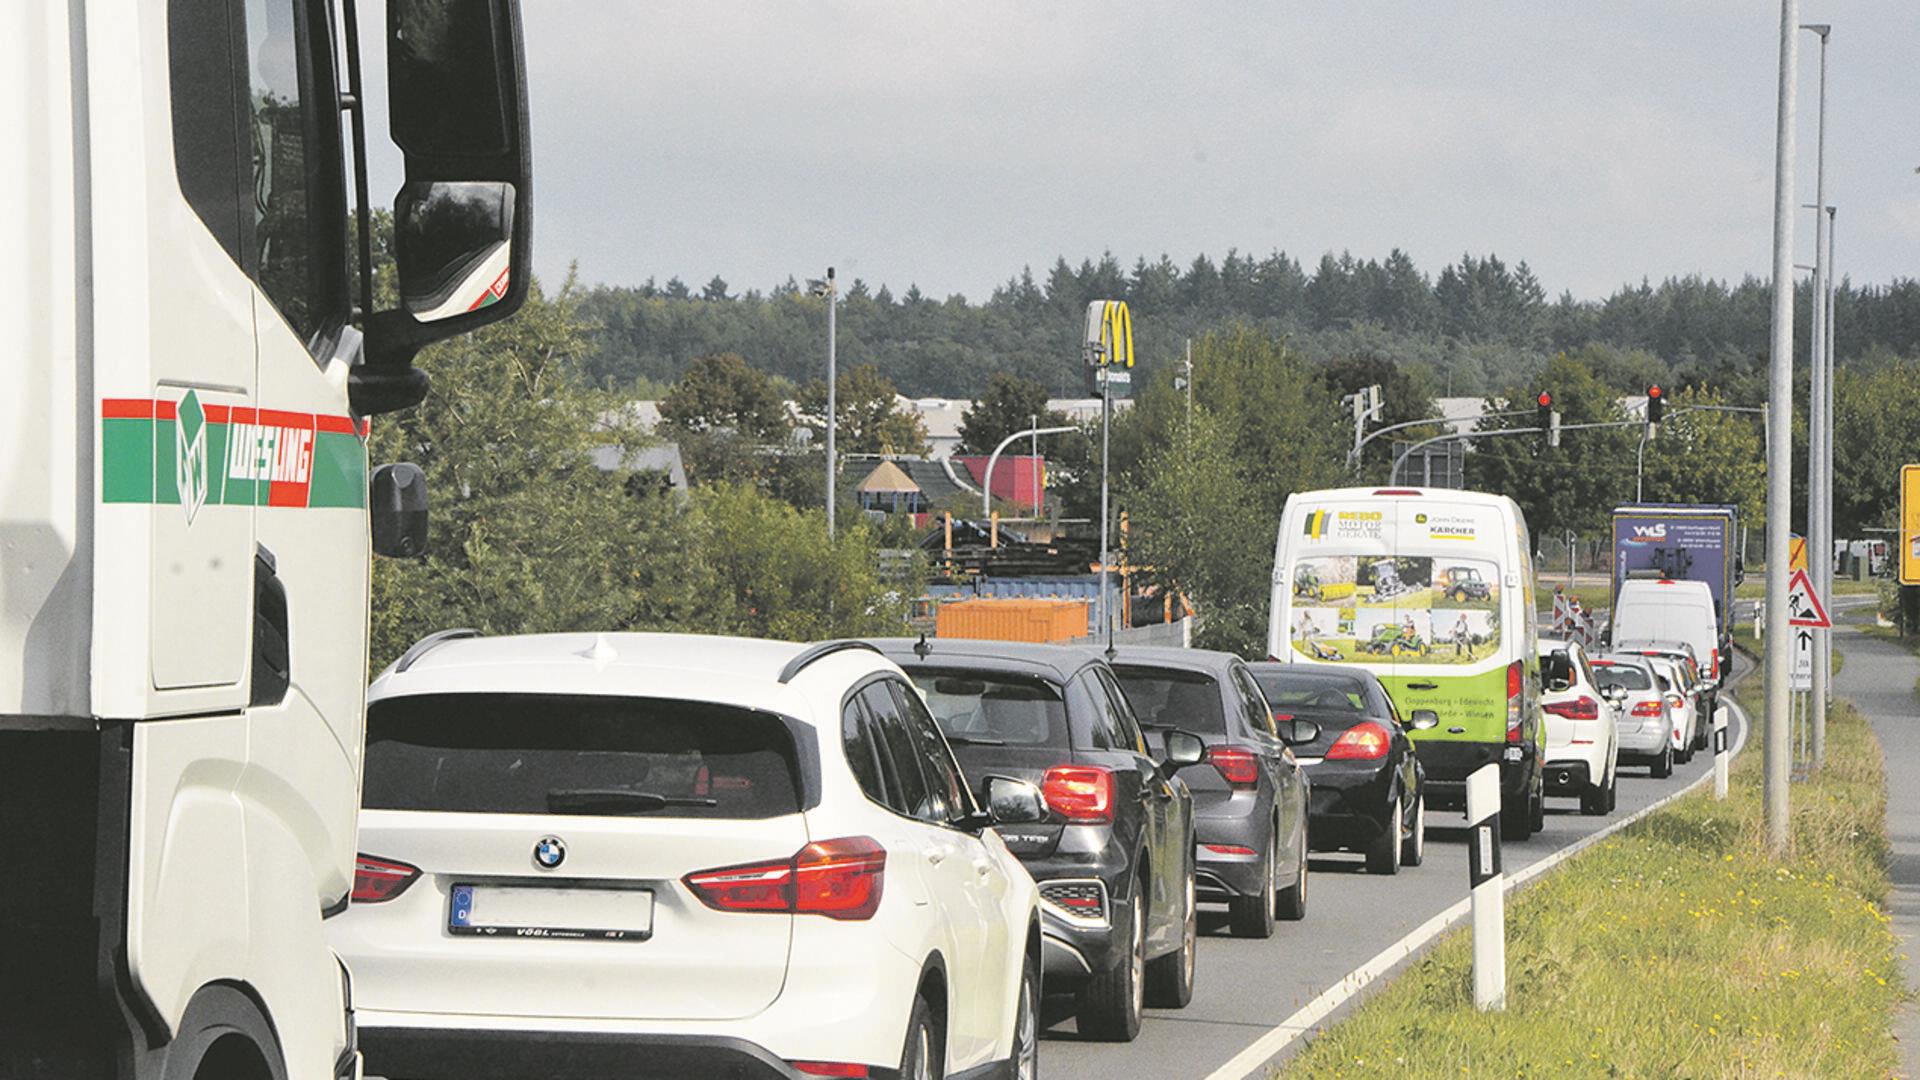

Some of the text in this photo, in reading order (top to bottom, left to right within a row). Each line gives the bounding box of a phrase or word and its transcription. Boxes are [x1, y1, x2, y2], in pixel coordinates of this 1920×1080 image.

[229, 423, 313, 483] WESLING
[1338, 521, 1382, 531] MOTOR
[458, 909, 467, 919] D
